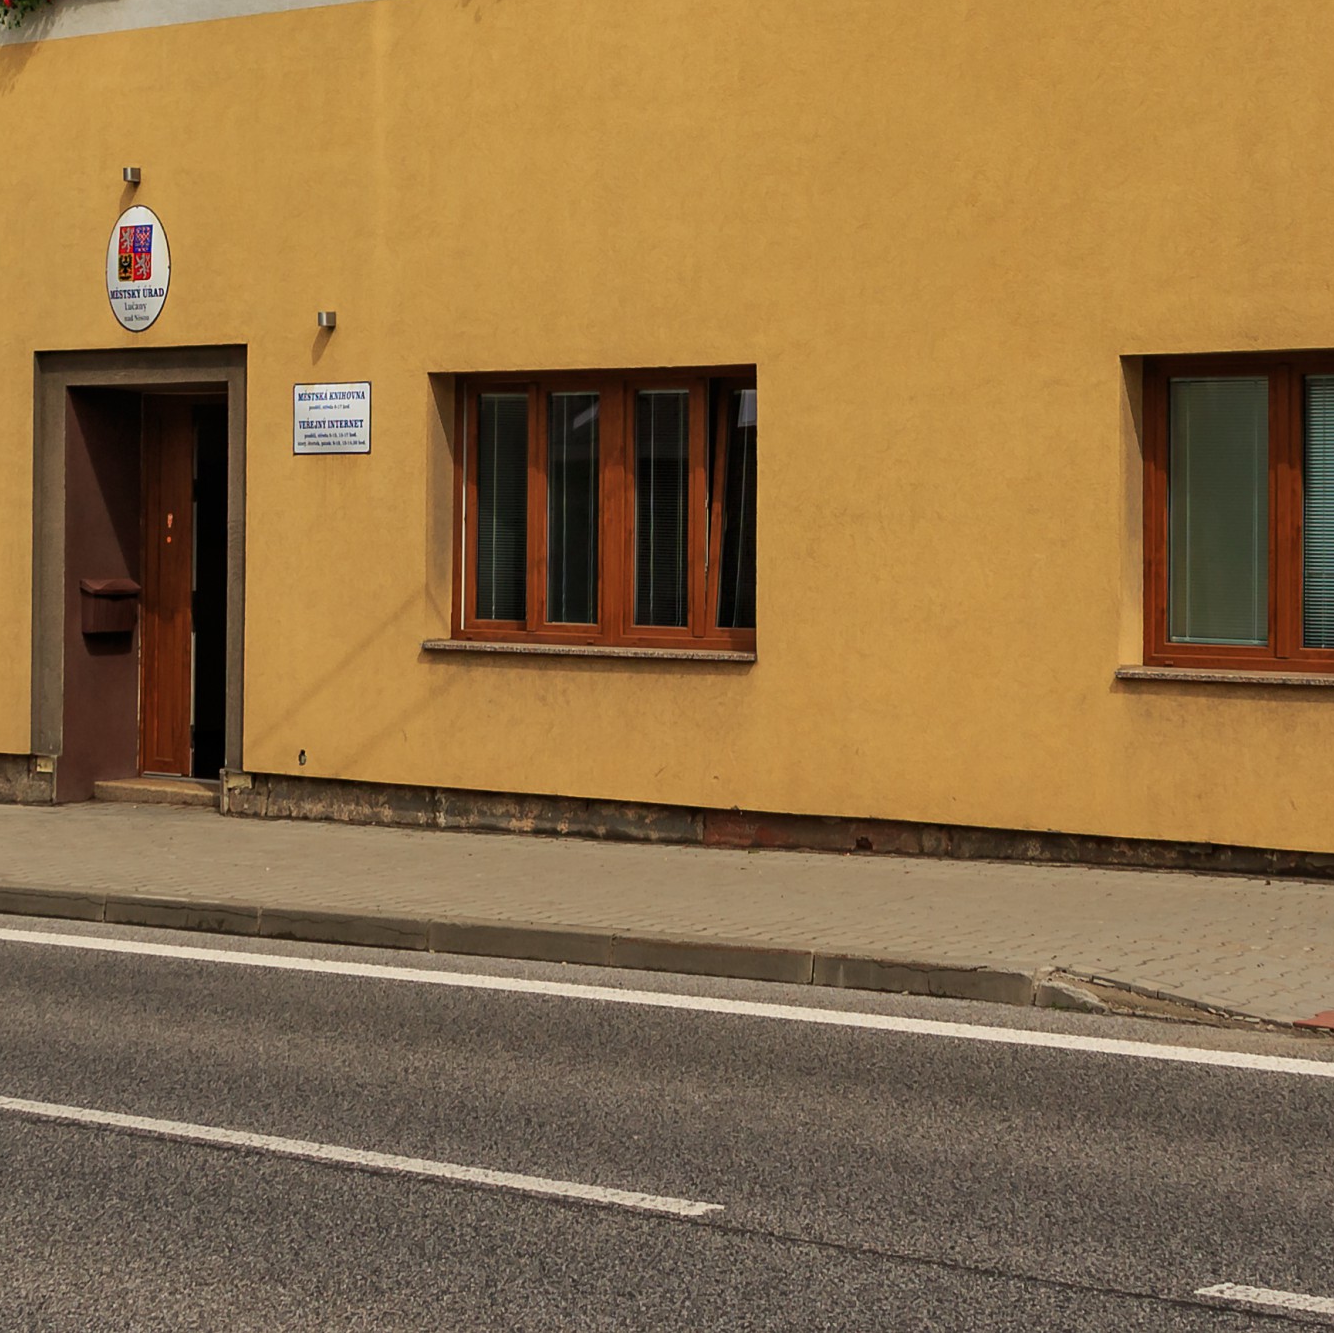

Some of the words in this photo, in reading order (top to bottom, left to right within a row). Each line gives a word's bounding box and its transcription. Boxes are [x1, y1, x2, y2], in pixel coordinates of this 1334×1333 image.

[110, 286, 141, 299] MĚSTSKÝ
[143, 285, 165, 298] ÚŘAD
[124, 302, 147, 312] Lučany
[298, 389, 328, 401] MĚSTSKÁ
[329, 391, 365, 400] KNIHOVNA
[298, 417, 326, 429] VEŘEJNÝ
[327, 419, 364, 429] INTERNET
